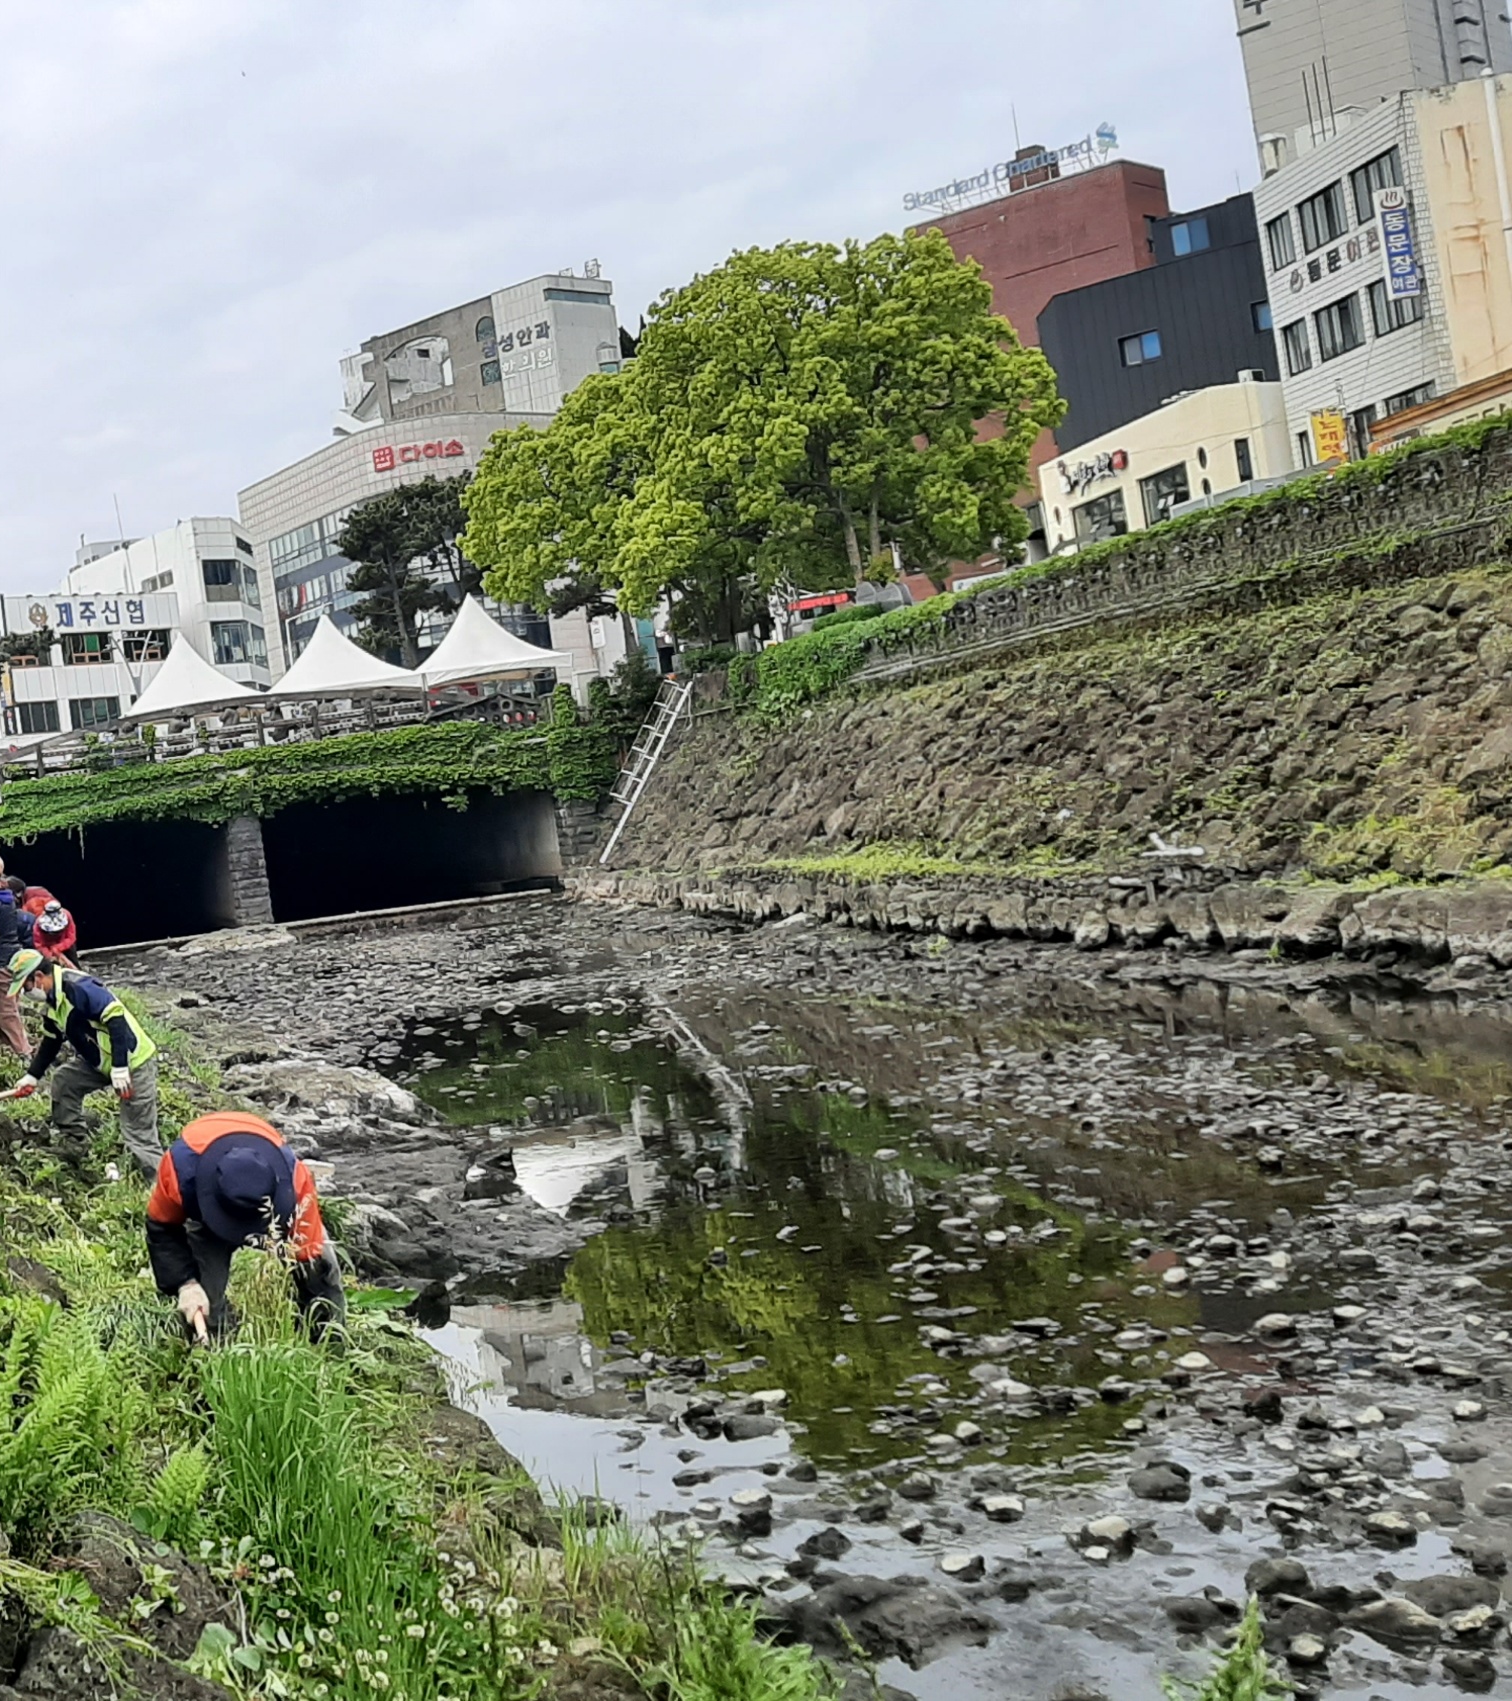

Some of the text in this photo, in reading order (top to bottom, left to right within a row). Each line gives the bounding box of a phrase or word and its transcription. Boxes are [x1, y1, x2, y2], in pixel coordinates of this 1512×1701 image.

[903, 133, 1093, 211] Standard Chartered
[1385, 211, 1413, 274] 동문장
[1392, 275, 1418, 291] 여관
[399, 439, 465, 462] 다이소
[55, 599, 145, 627] 제주신협
